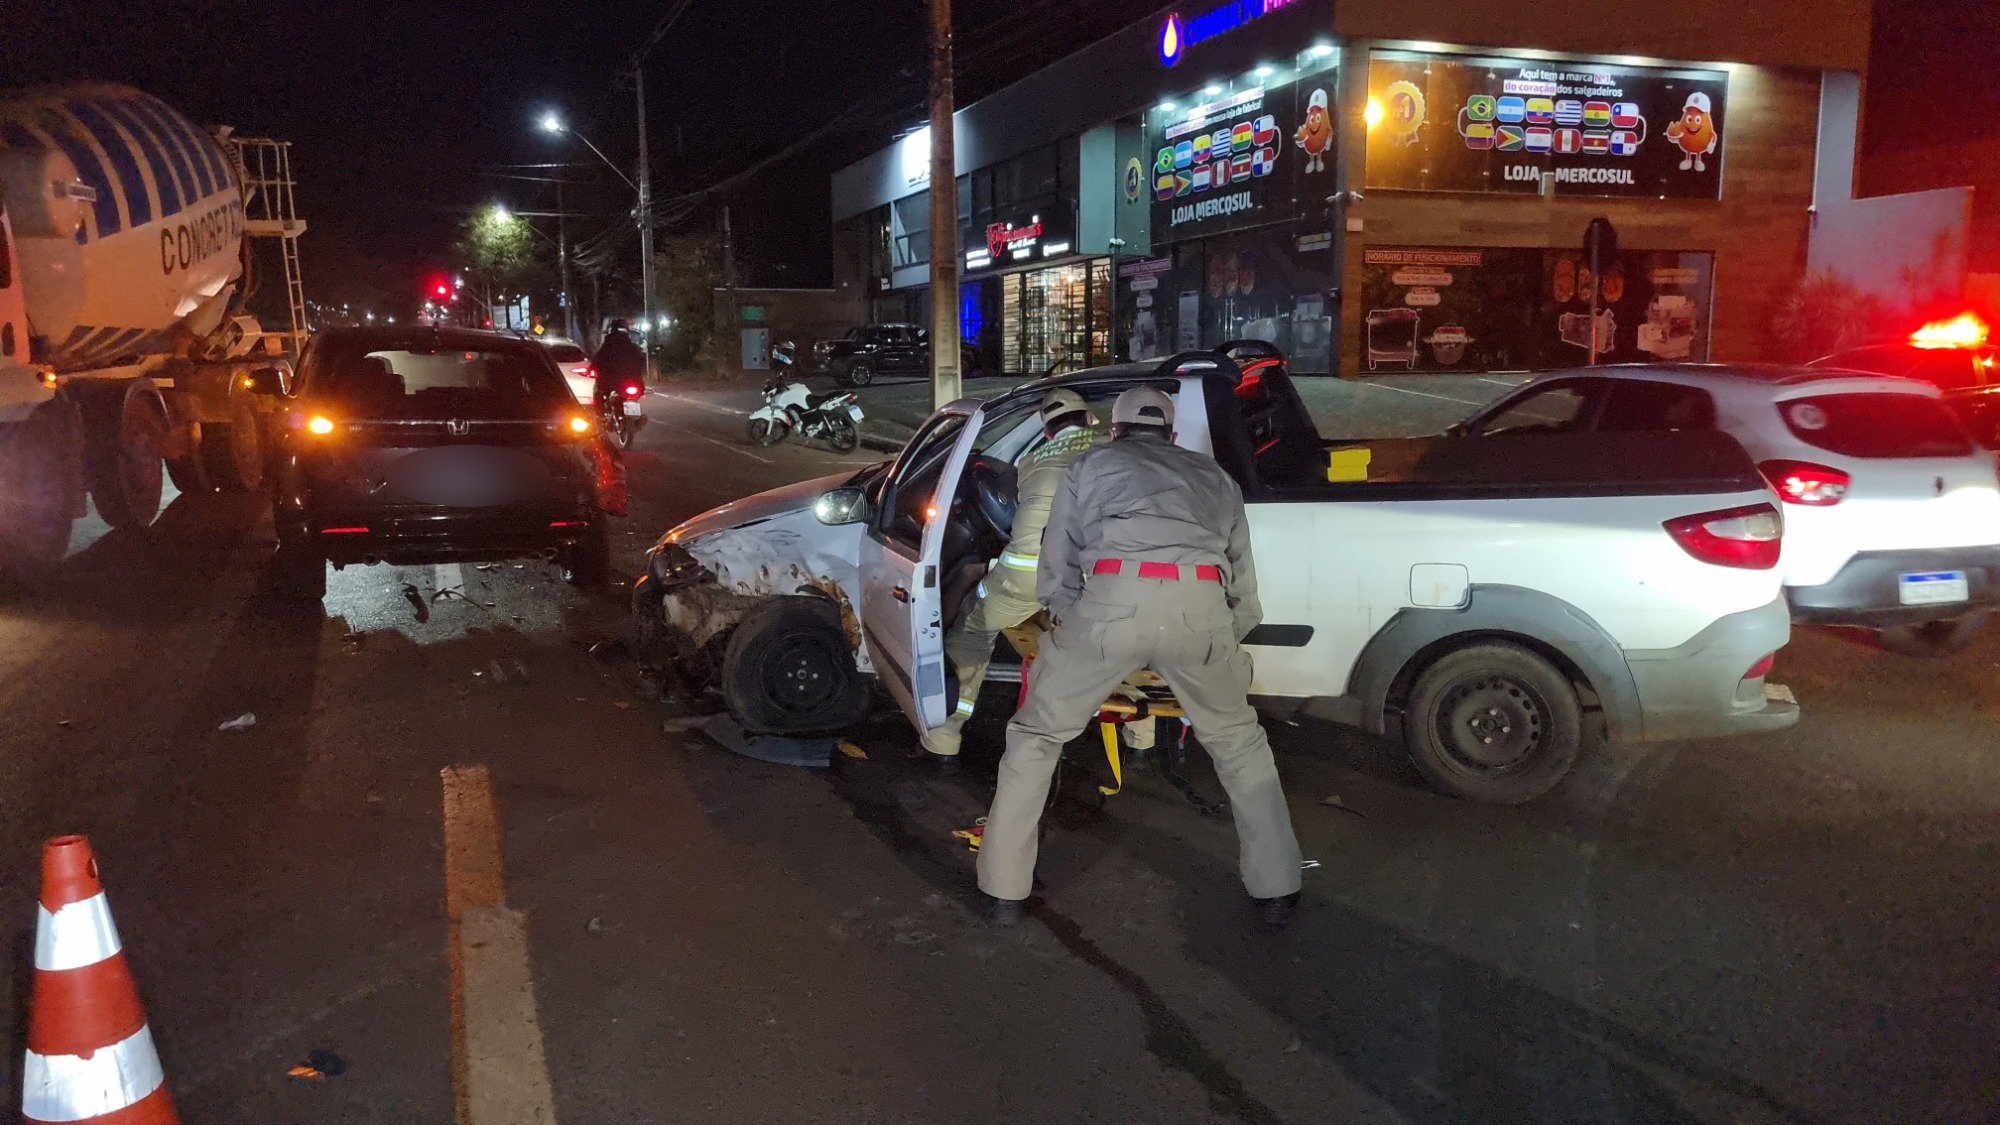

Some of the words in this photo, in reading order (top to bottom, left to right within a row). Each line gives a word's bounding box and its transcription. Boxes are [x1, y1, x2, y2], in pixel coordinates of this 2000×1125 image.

[1519, 68, 1539, 81] Aqui
[1541, 70, 1557, 81] tem
[1559, 73, 1565, 81] a
[1566, 74, 1593, 83] marca
[1505, 82, 1517, 91] do
[1518, 83, 1555, 94] coração
[1557, 84, 1573, 94] dos
[1574, 86, 1623, 97] salgadeiros
[1504, 165, 1540, 181] LOJA
[1555, 167, 1635, 184] MERCOSUL
[1172, 204, 1195, 224] LOJA
[1195, 190, 1253, 219] MERCOSUL
